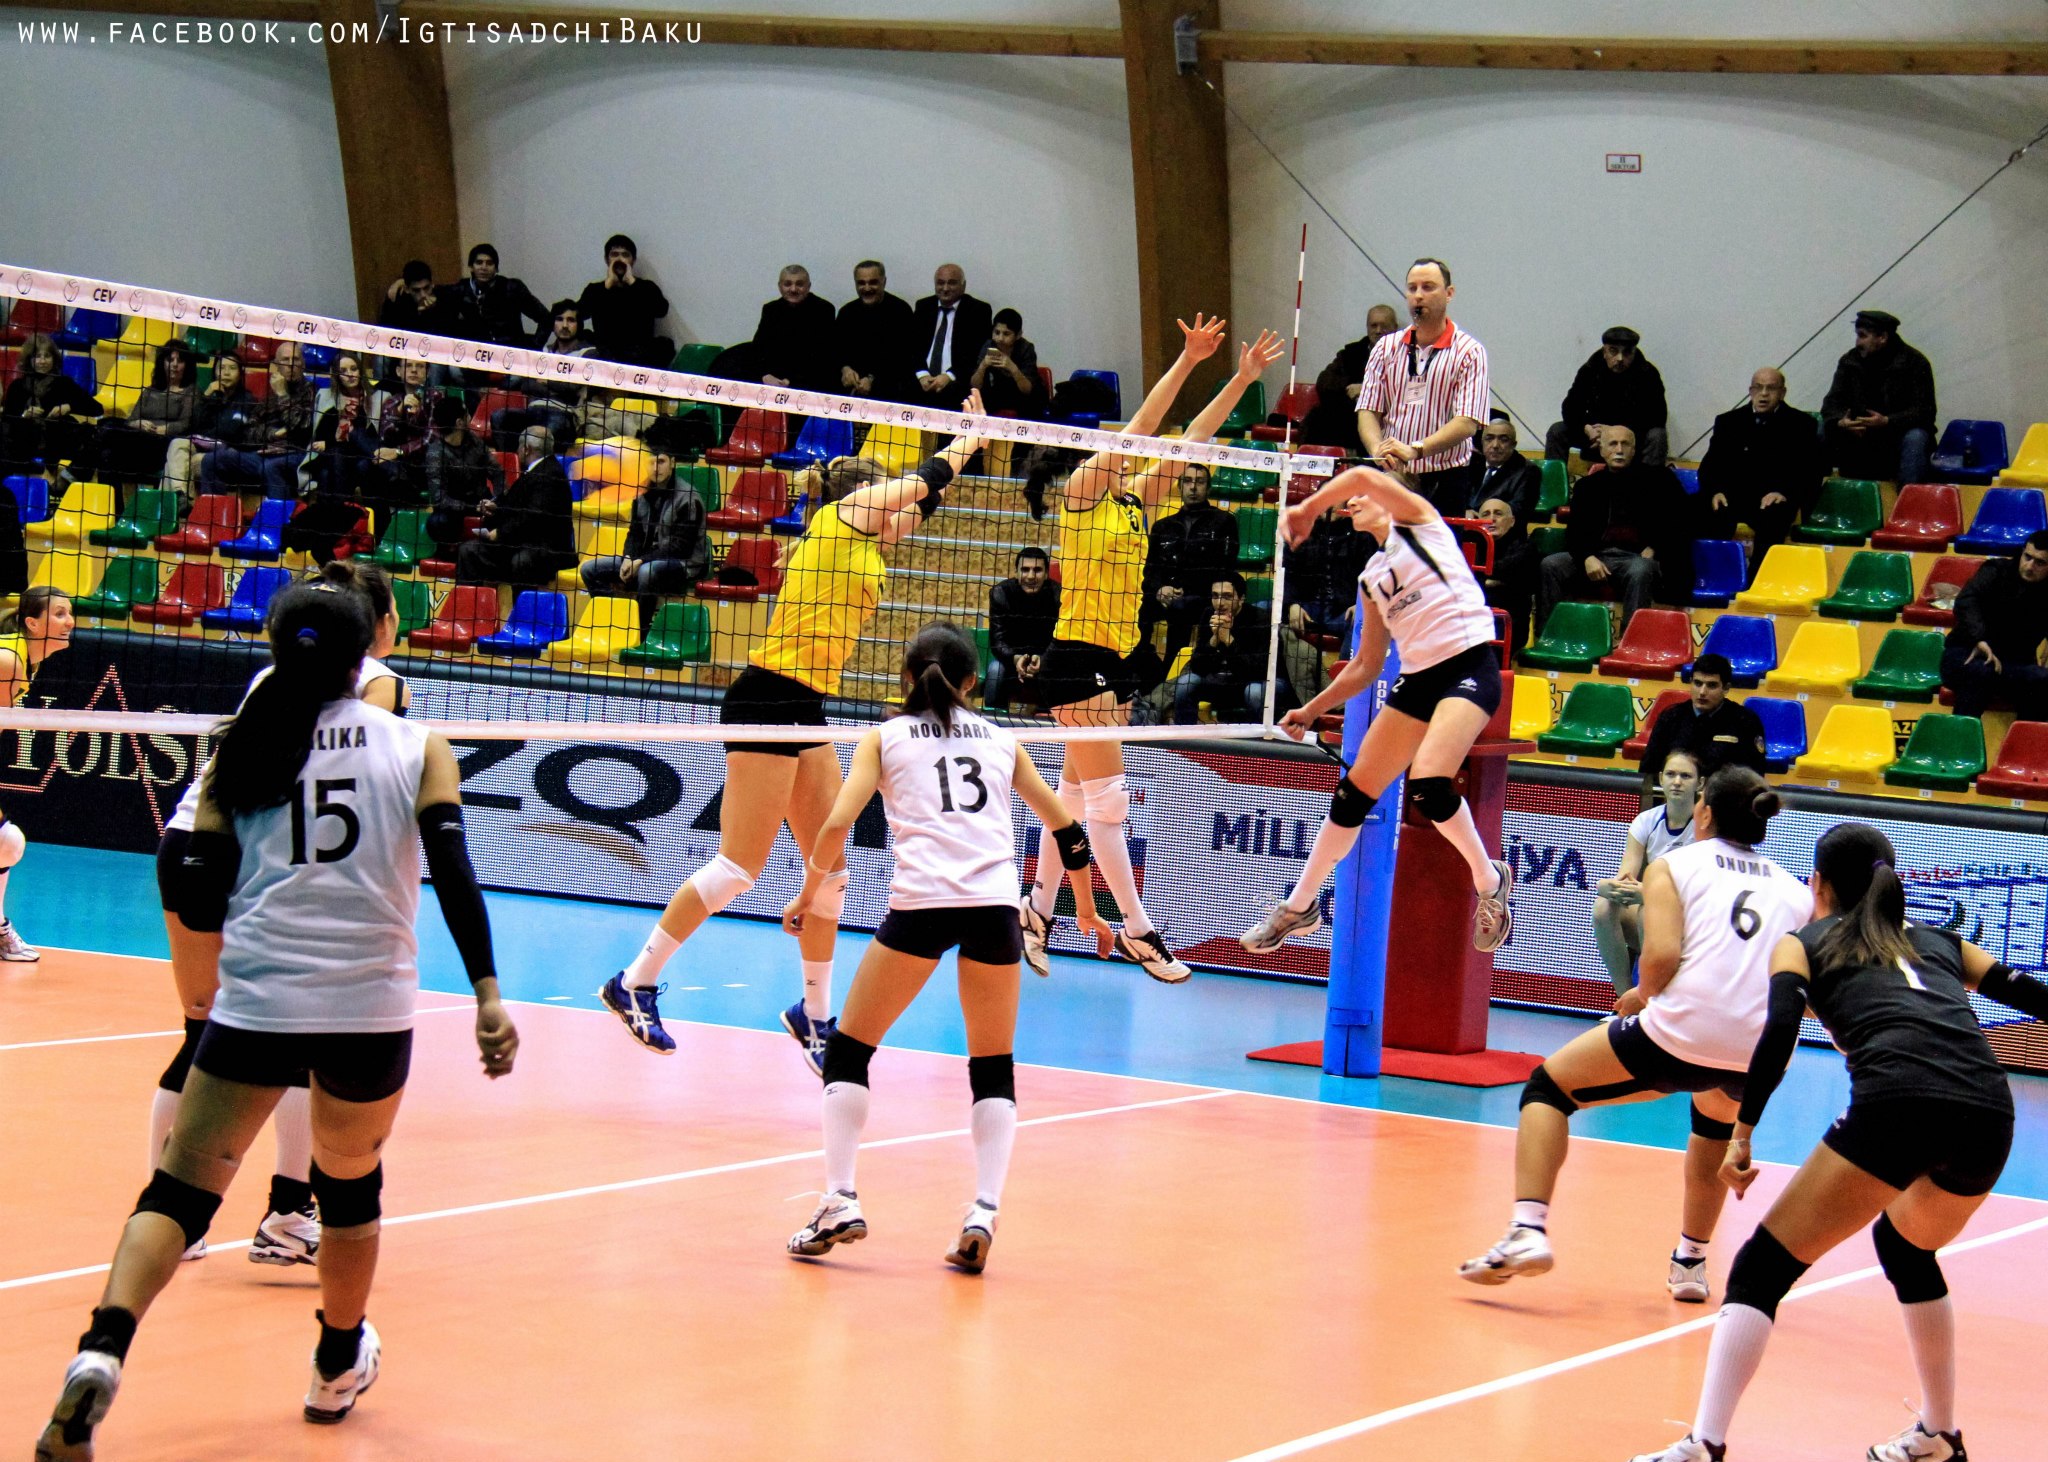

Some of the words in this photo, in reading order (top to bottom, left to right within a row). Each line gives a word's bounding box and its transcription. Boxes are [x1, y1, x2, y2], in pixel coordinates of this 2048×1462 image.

[93, 288, 118, 304] CEV
[200, 306, 221, 321] CEV
[298, 321, 318, 335] CEV
[389, 336, 409, 351] CEV
[475, 349, 495, 363] CEV
[557, 362, 575, 375] CEV
[634, 374, 650, 386] CEV
[706, 384, 722, 396] CEV
[775, 394, 790, 405] CEV
[839, 403, 854, 414] CEV
[901, 411, 916, 422] CEV
[961, 419, 974, 430] CEV
[1017, 426, 1030, 436] CEV
[1071, 432, 1083, 443] CEV
[1122, 440, 1134, 449] CEV
[1171, 445, 1183, 455] CEV
[1219, 451, 1230, 461] CEV
[1264, 457, 1275, 466] CEV
[1308, 461, 1318, 470] CEV
[310, 726, 367, 751] LIKA
[932, 755, 988, 814] 13
[289, 777, 361, 866] 15
[1716, 854, 1772, 878] ONUMA
[1730, 889, 1763, 941] 6
